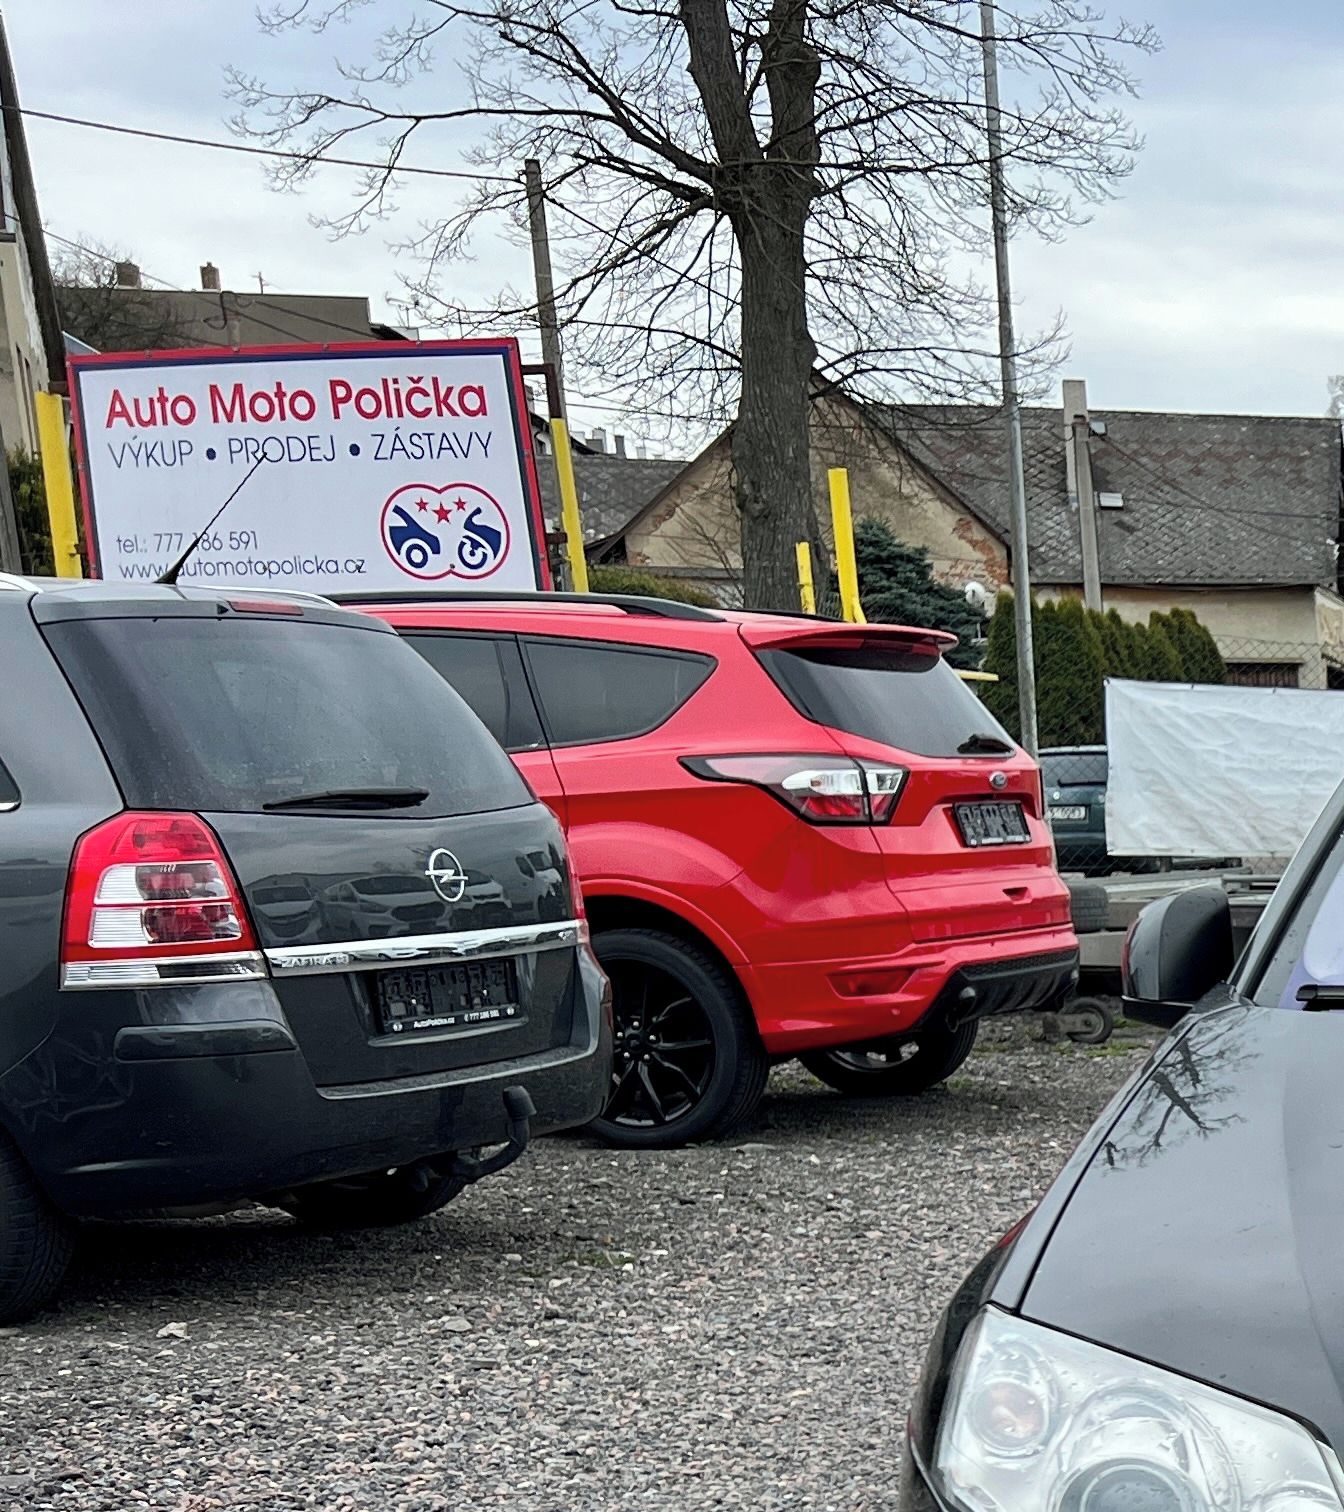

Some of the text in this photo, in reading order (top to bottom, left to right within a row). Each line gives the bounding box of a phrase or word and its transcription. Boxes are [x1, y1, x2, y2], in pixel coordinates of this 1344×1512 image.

[105, 375, 488, 429] Auto Moto Polička
[107, 426, 493, 469] VÝKUP PRODEJ ZÁSTAVY
[116, 535, 148, 554] tel.:
[153, 532, 183, 552] 777
[228, 530, 258, 550] 591
[118, 555, 367, 580] wwwautomotopolicka.cz
